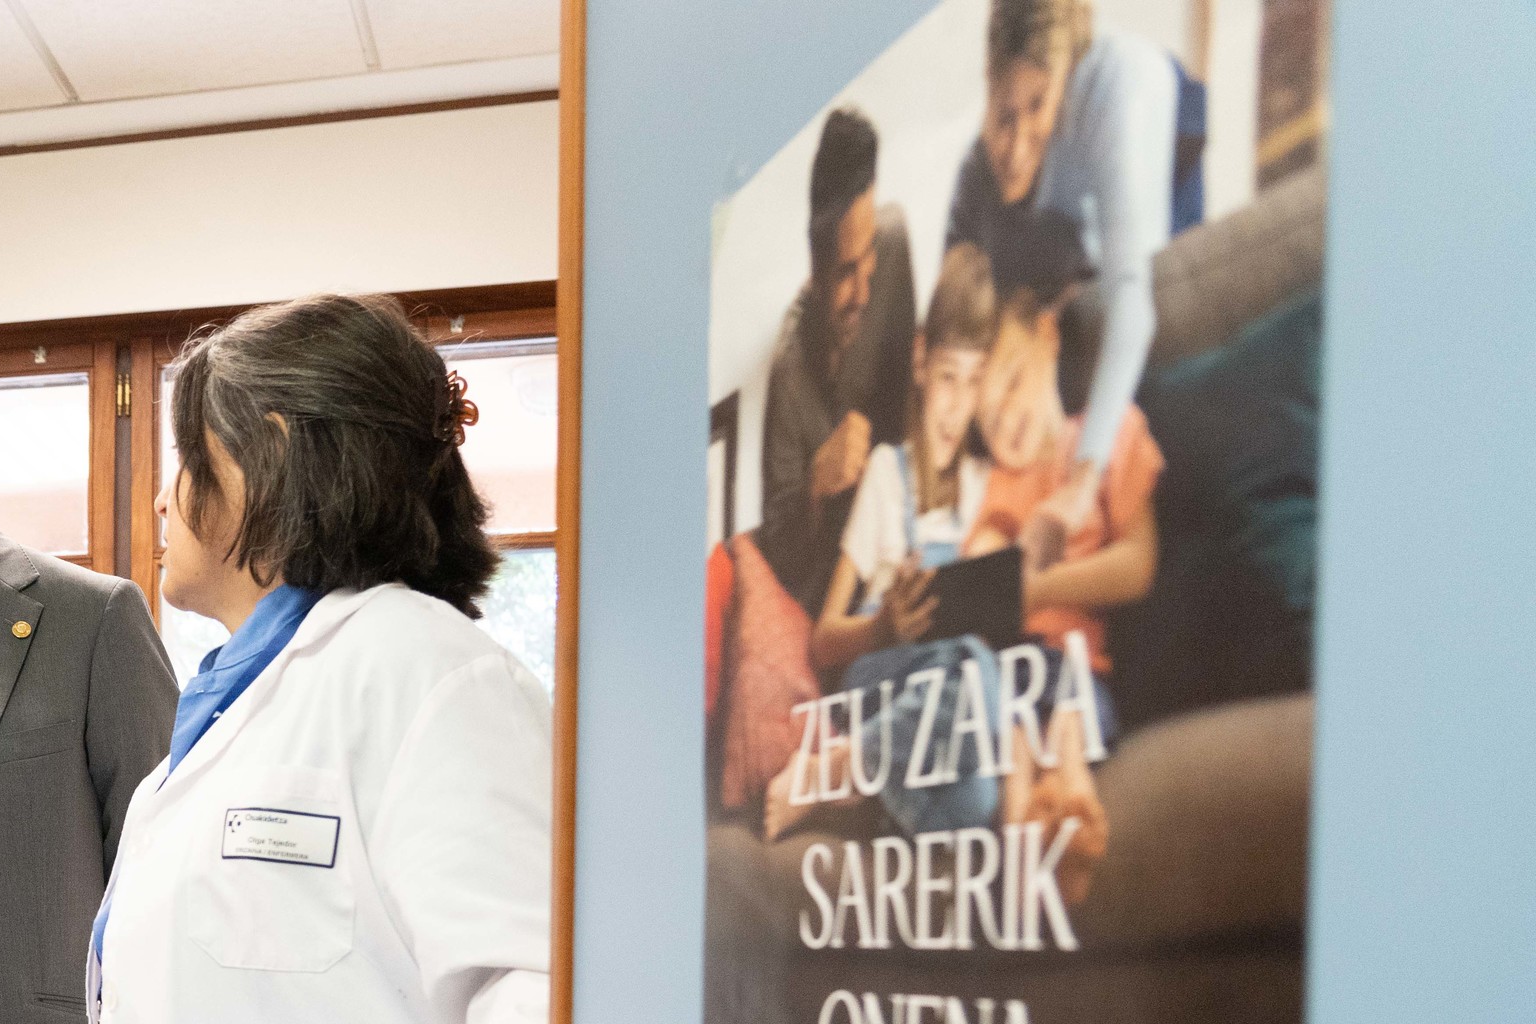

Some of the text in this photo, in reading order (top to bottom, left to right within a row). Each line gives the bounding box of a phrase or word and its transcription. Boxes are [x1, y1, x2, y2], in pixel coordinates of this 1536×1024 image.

[789, 630, 1109, 806] ZEU ZARA
[799, 817, 1080, 952] SARERIK
